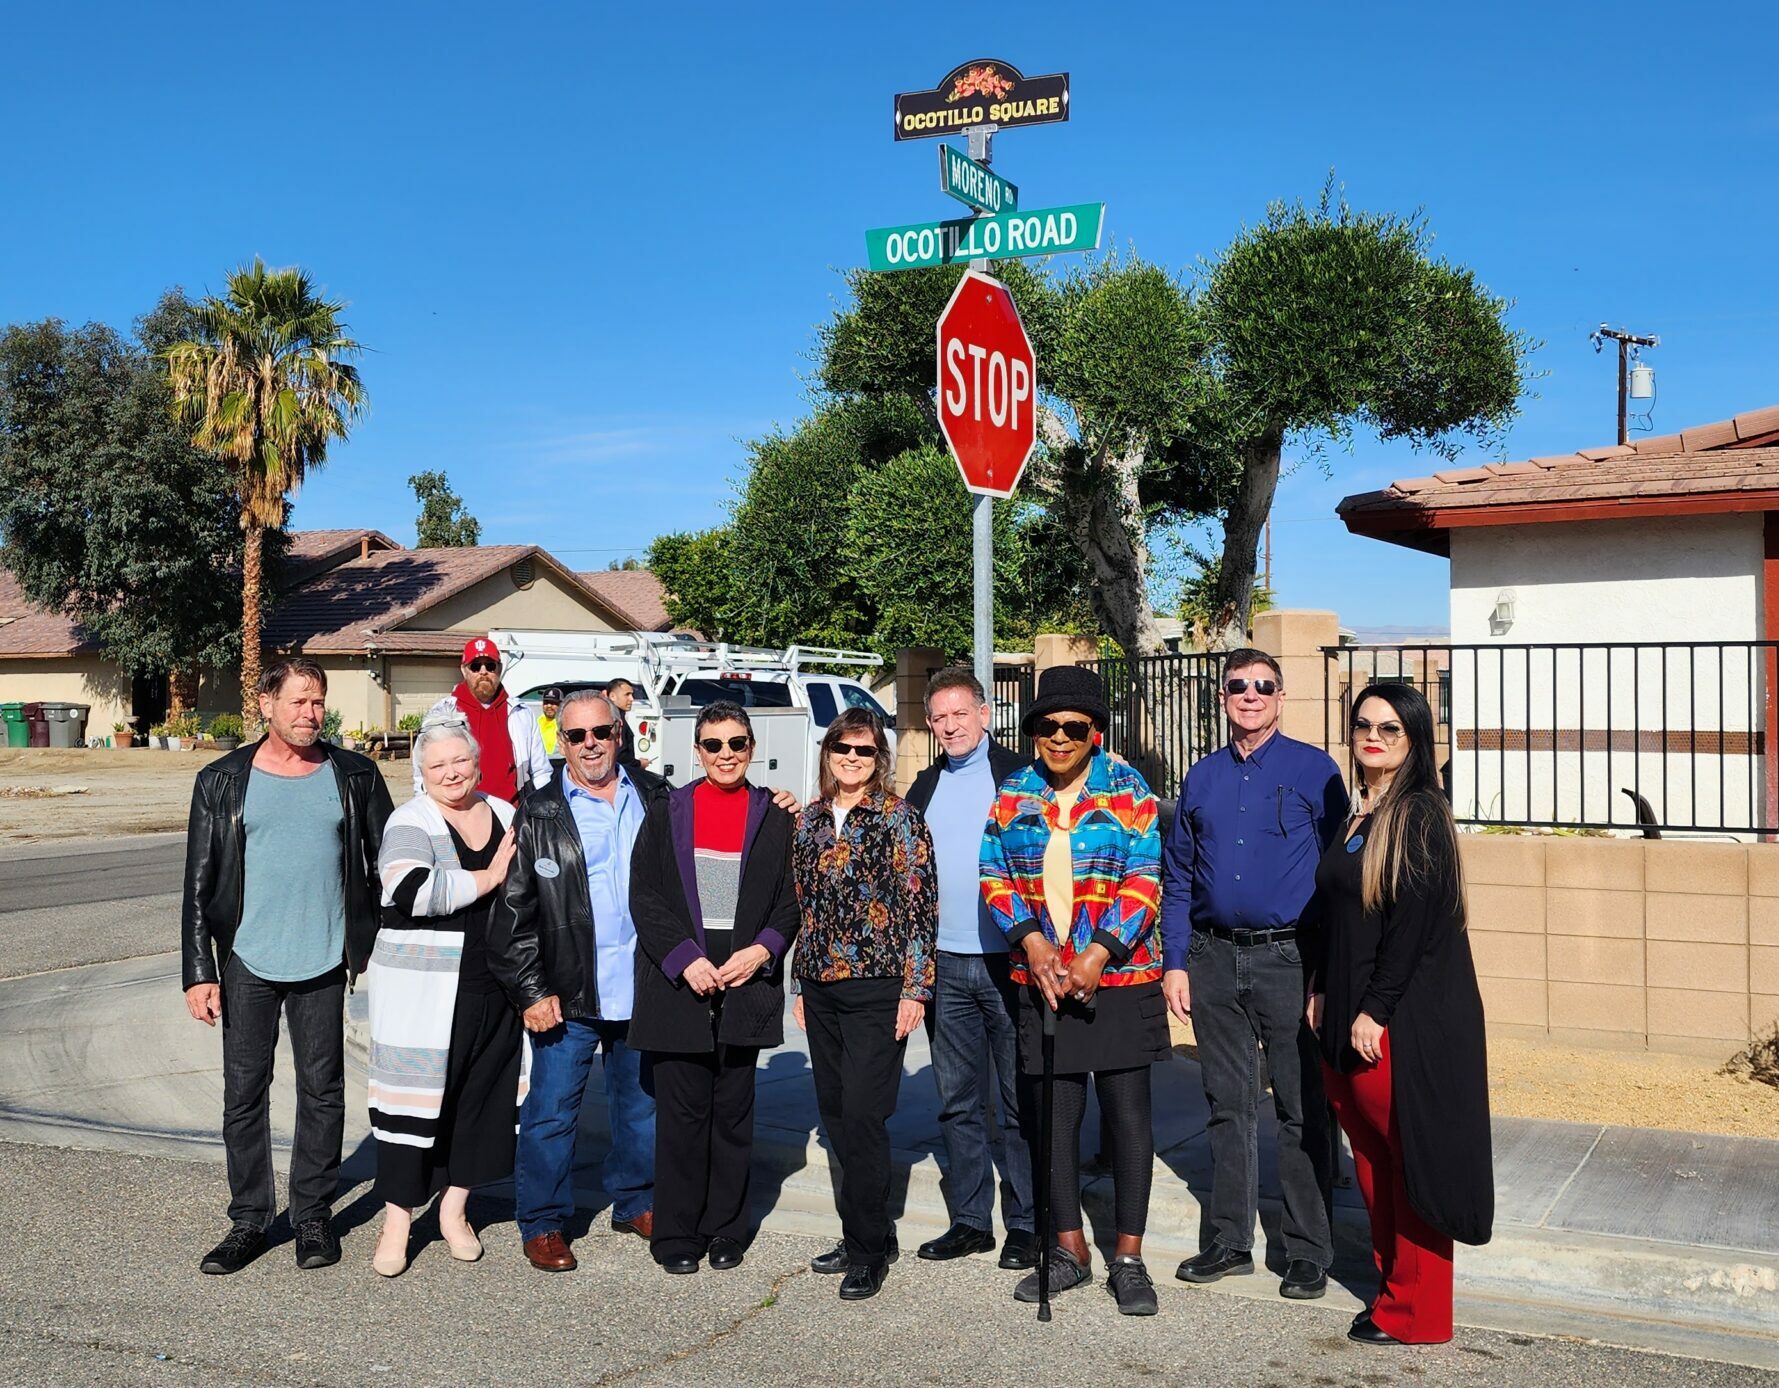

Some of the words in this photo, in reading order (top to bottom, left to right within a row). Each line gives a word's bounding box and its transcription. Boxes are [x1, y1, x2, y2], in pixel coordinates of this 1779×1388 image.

[903, 106, 984, 131] OCOTILLO
[989, 97, 1060, 122] SQUARE
[951, 154, 1001, 211] MORENO
[1004, 186, 1013, 205] RD
[886, 222, 1001, 264] OCOTILLO
[1007, 212, 1077, 251] ROAD
[946, 337, 1029, 431] STOP
